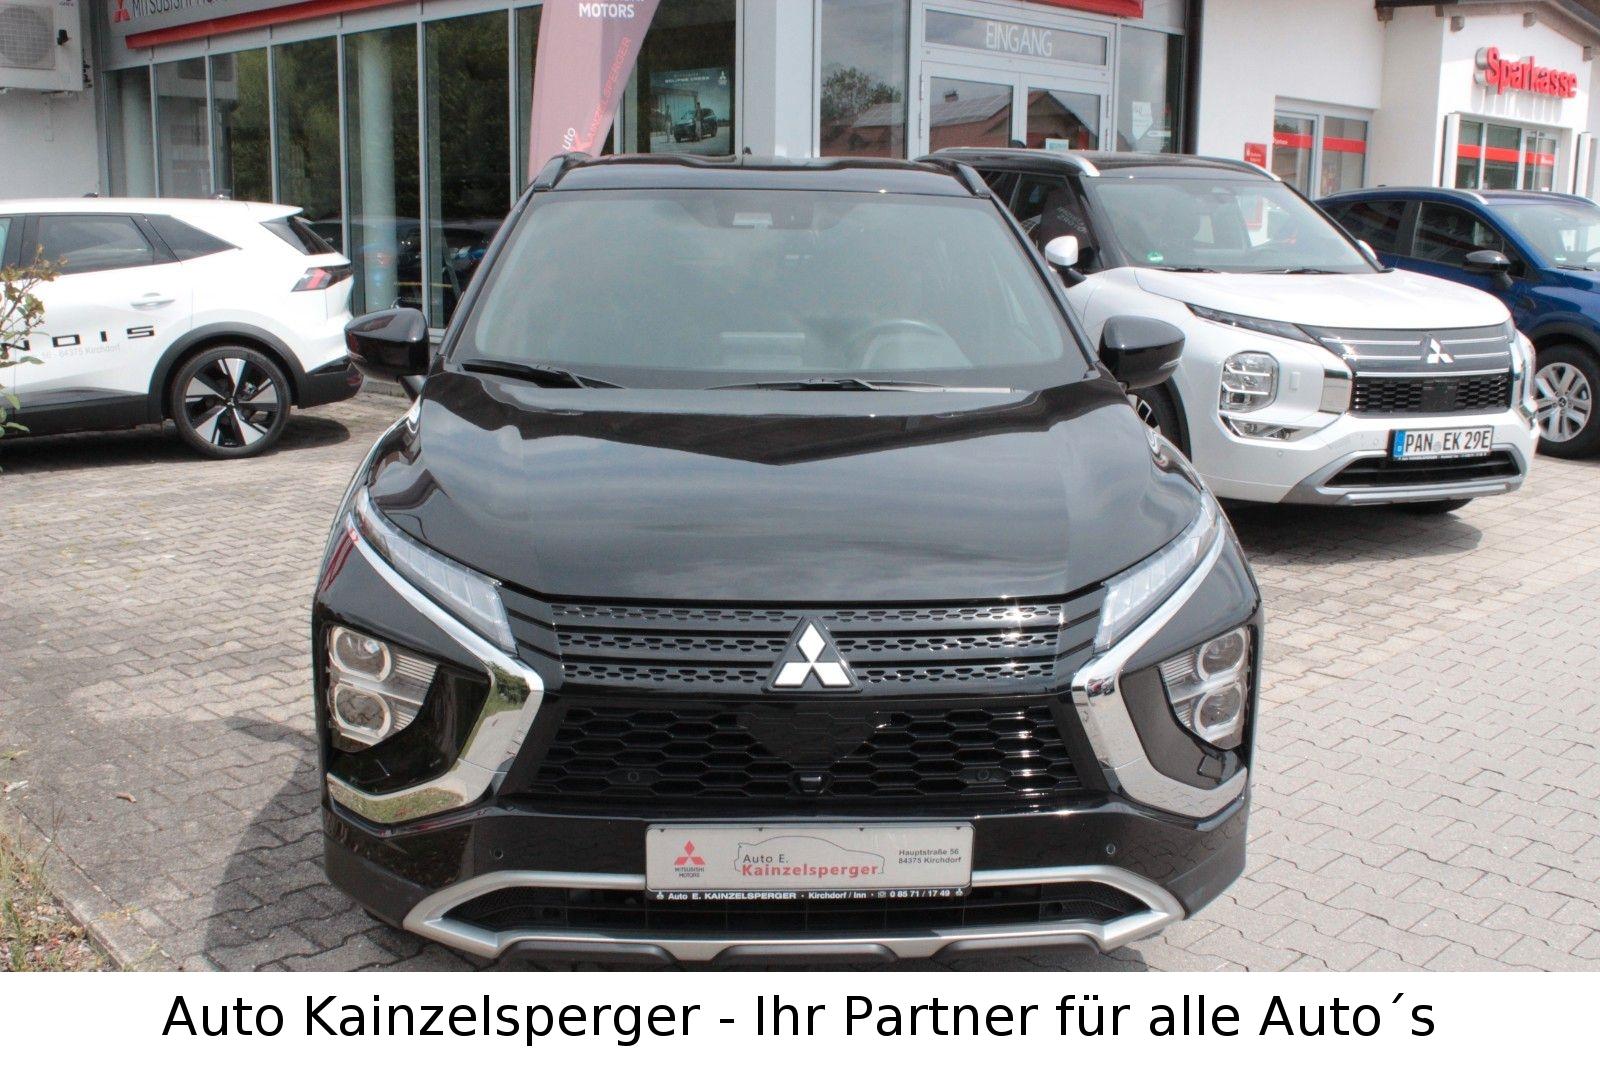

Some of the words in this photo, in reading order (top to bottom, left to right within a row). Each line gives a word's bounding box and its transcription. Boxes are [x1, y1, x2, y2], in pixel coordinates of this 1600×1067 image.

[579, 3, 635, 18] MOTORS
[986, 21, 1053, 57] EINGANG
[1483, 46, 1578, 99] Sparkasse
[562, 127, 576, 150] uto
[1405, 433, 1434, 453] PAN
[1442, 431, 1462, 451] EK
[1464, 430, 1490, 450] 29E
[743, 854, 773, 863] Auto
[779, 854, 788, 863] E.
[899, 849, 947, 857] Hauptstraße
[924, 856, 961, 864] Kirchdorf
[742, 864, 878, 879] Kainzelsperger
[704, 892, 796, 900] KAINZELSPERGER
[808, 891, 847, 899] Kirchdorf
